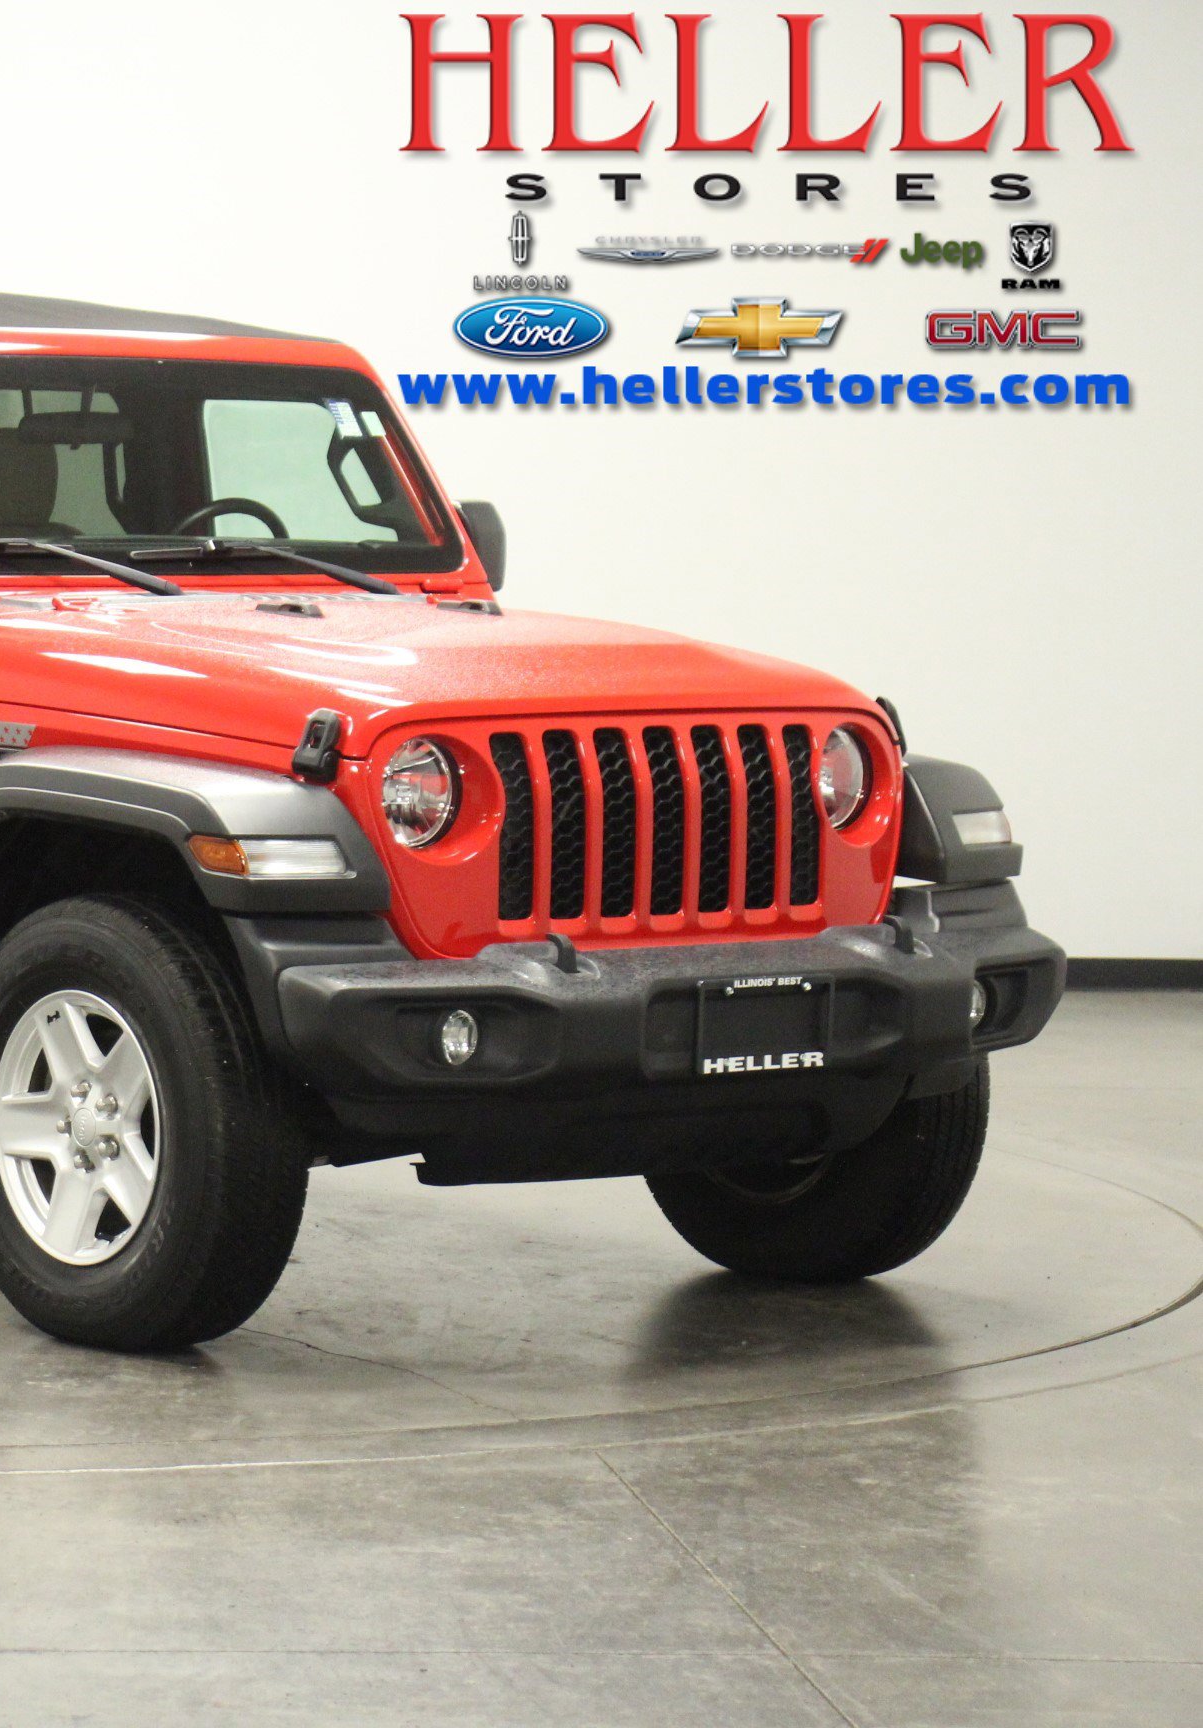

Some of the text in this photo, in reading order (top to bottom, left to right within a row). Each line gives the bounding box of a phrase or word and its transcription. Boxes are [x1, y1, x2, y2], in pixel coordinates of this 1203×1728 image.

[733, 976, 803, 989] ILLINOIS' BEST
[703, 1052, 824, 1074] HELLER
